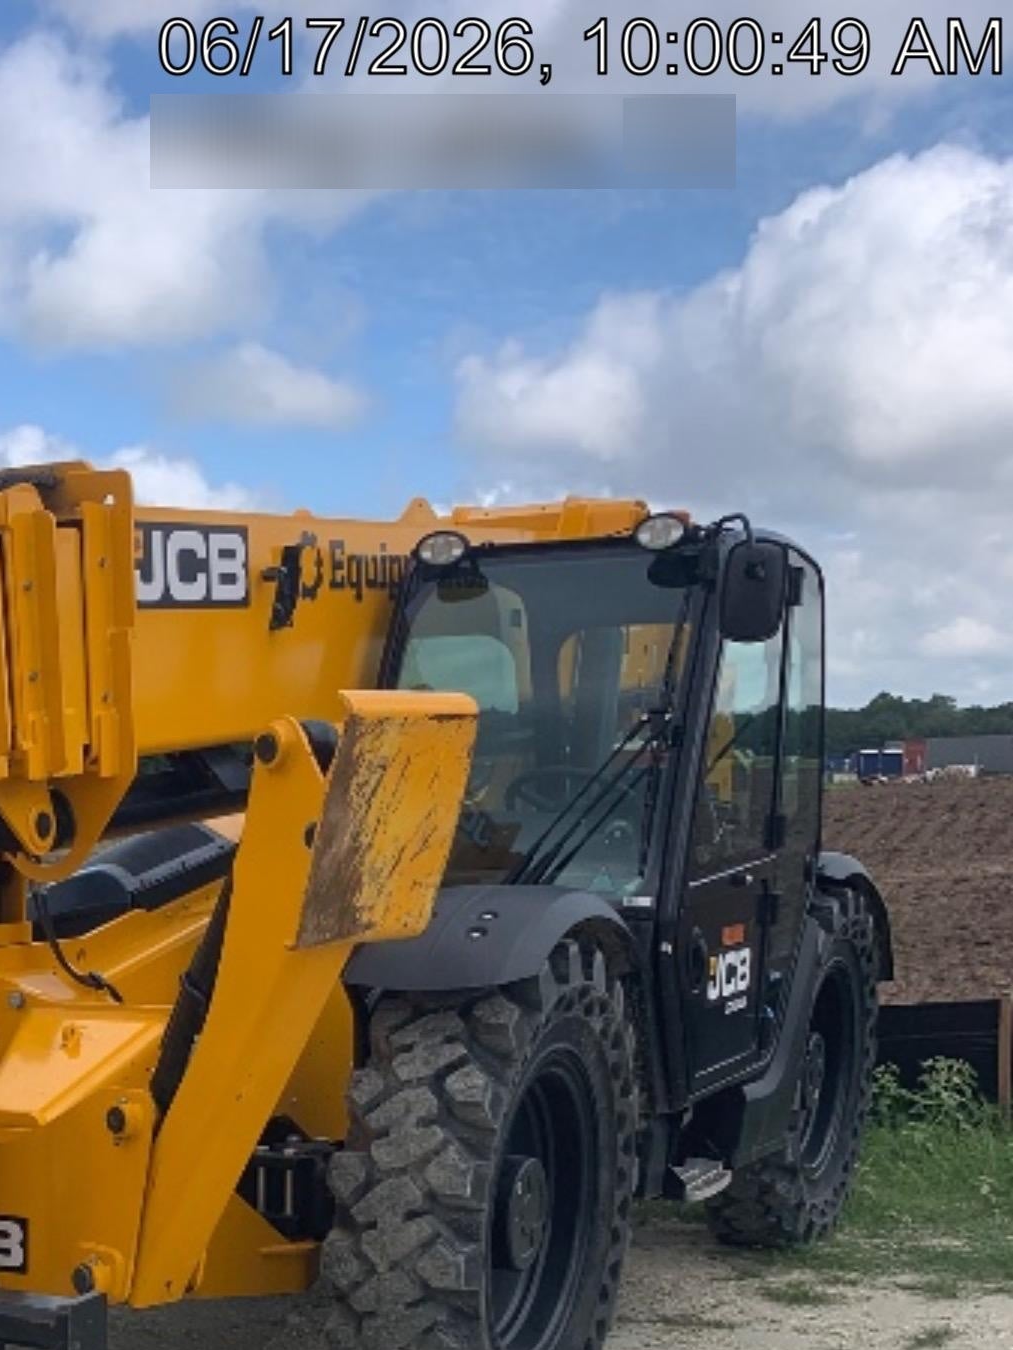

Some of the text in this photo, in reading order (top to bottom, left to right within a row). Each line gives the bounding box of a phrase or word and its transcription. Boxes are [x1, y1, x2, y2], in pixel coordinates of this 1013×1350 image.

[135, 529, 247, 601] JCB
[328, 539, 408, 601] Equip
[707, 947, 751, 1000] JCB
